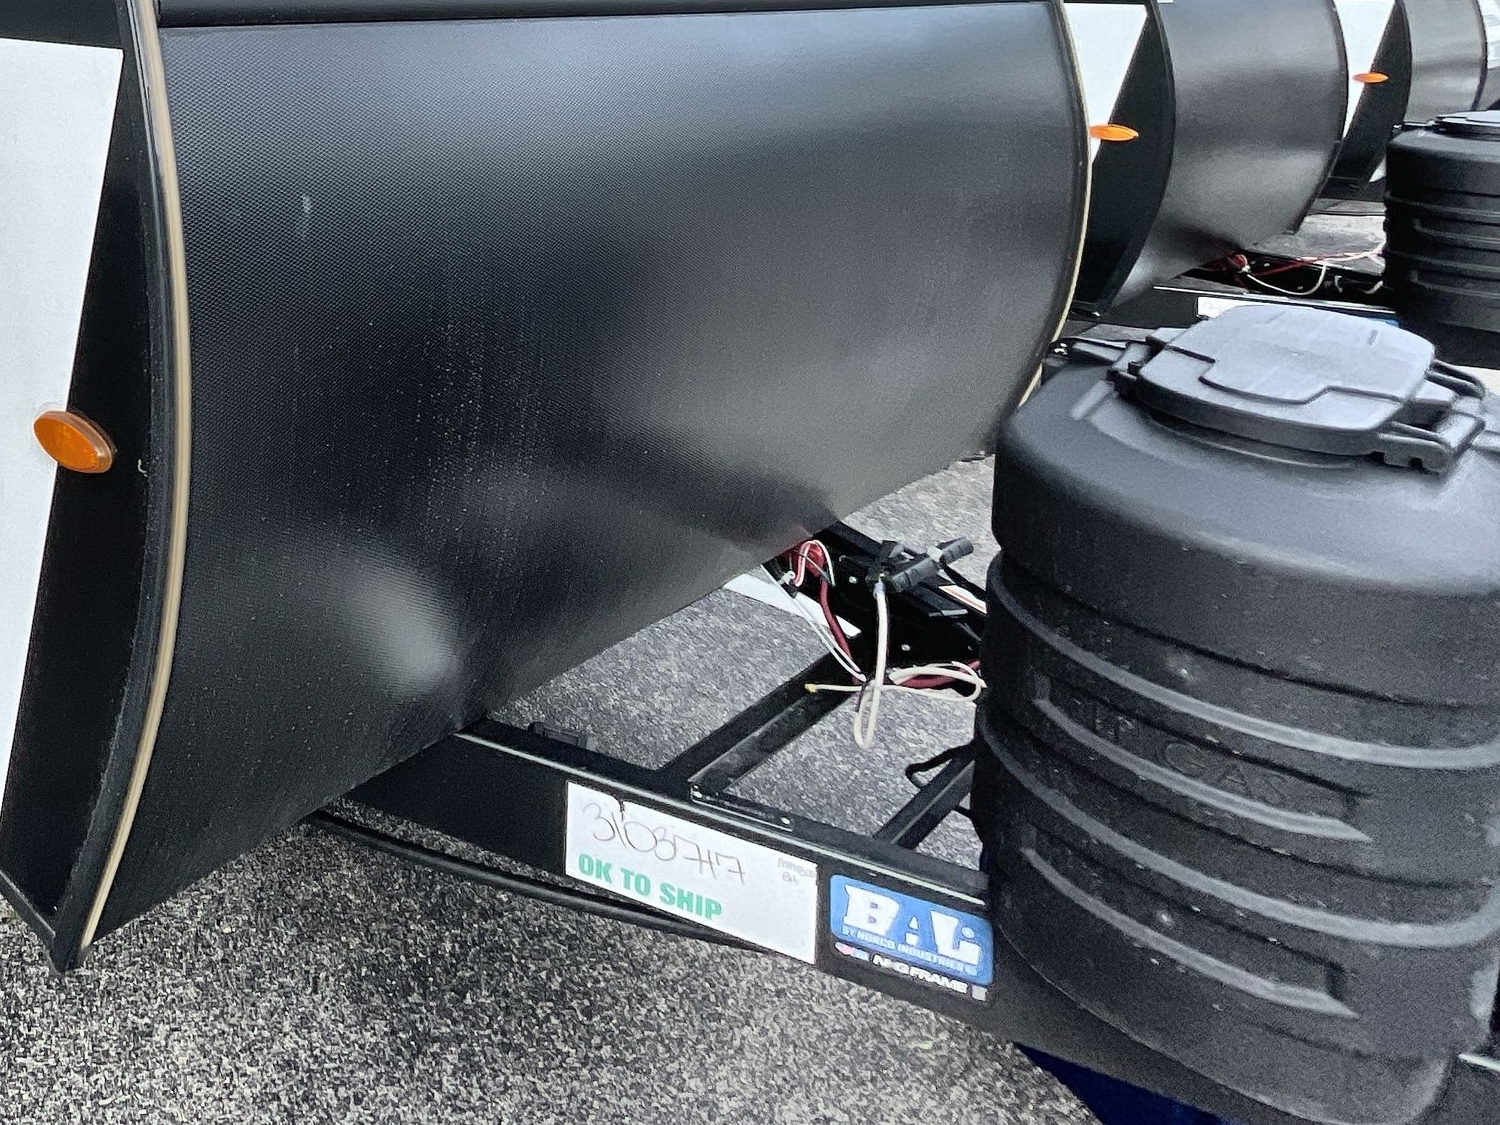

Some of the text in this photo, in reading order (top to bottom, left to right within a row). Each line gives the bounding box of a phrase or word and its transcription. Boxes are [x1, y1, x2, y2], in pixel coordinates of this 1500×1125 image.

[578, 853, 722, 920] OK TO SHIP
[843, 884, 981, 966] BAL
